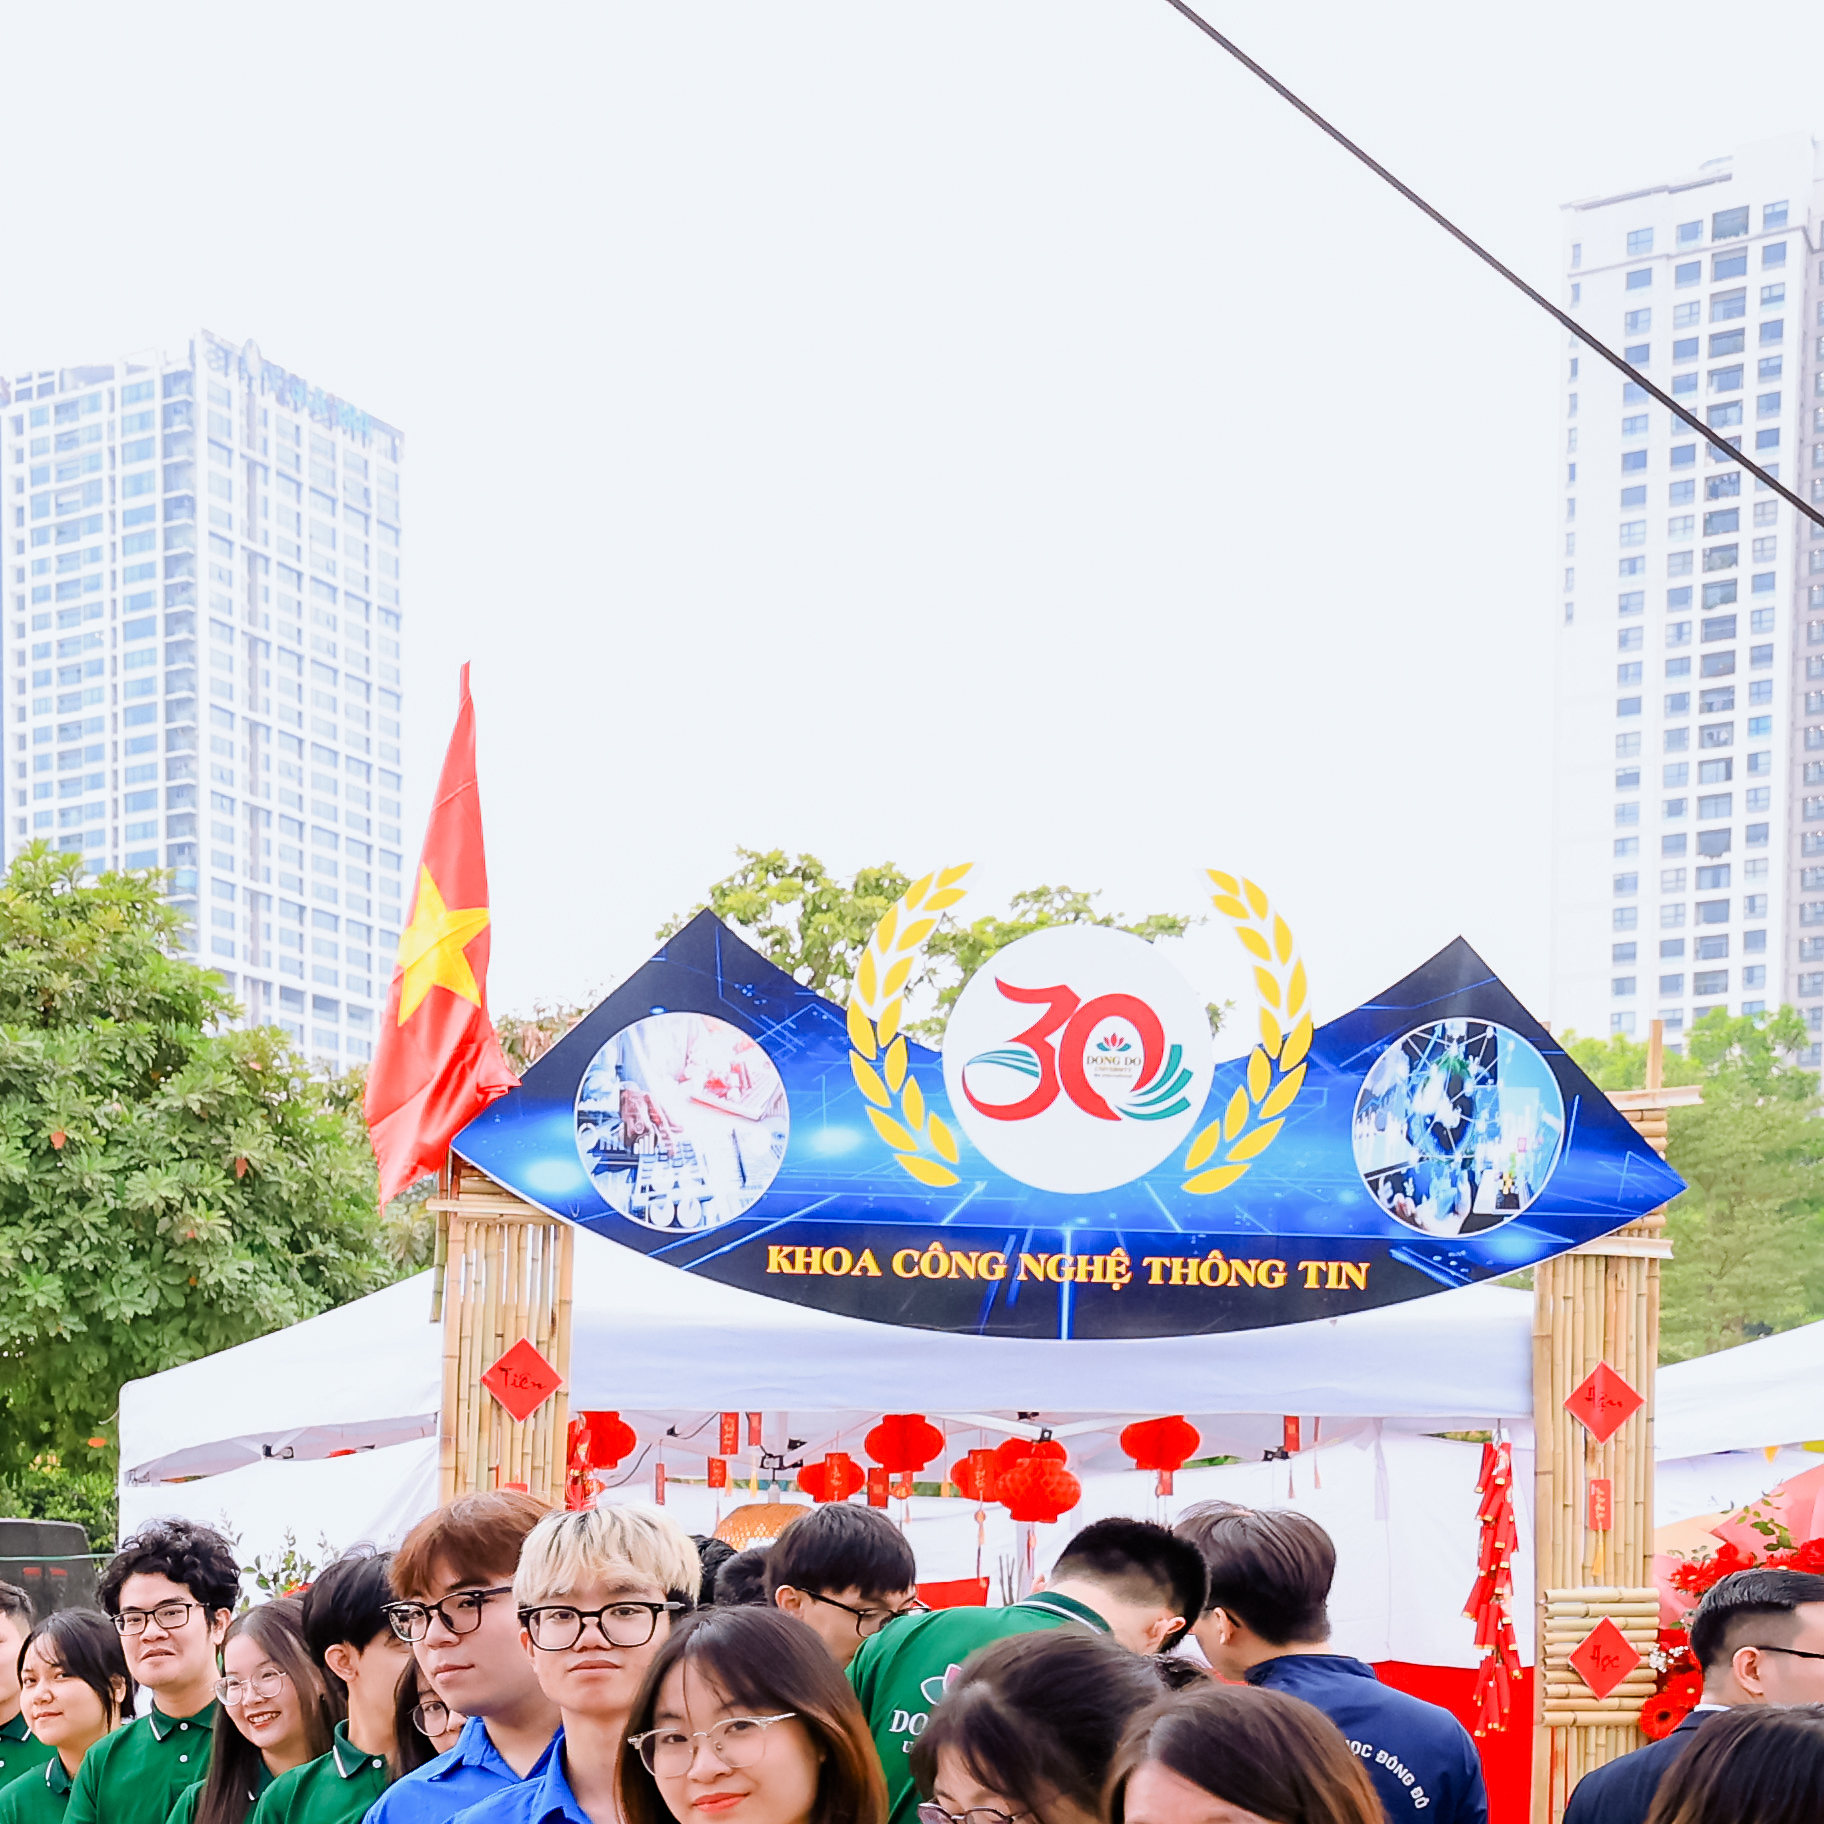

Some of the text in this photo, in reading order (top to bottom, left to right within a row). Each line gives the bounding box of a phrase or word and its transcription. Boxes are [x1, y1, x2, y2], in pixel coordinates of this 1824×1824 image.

[962, 976, 1165, 1121] 30
[766, 1241, 1370, 1290] KHOA CÔNG NGHỆ THÔNG TIN
[888, 1710, 929, 1736] DO
